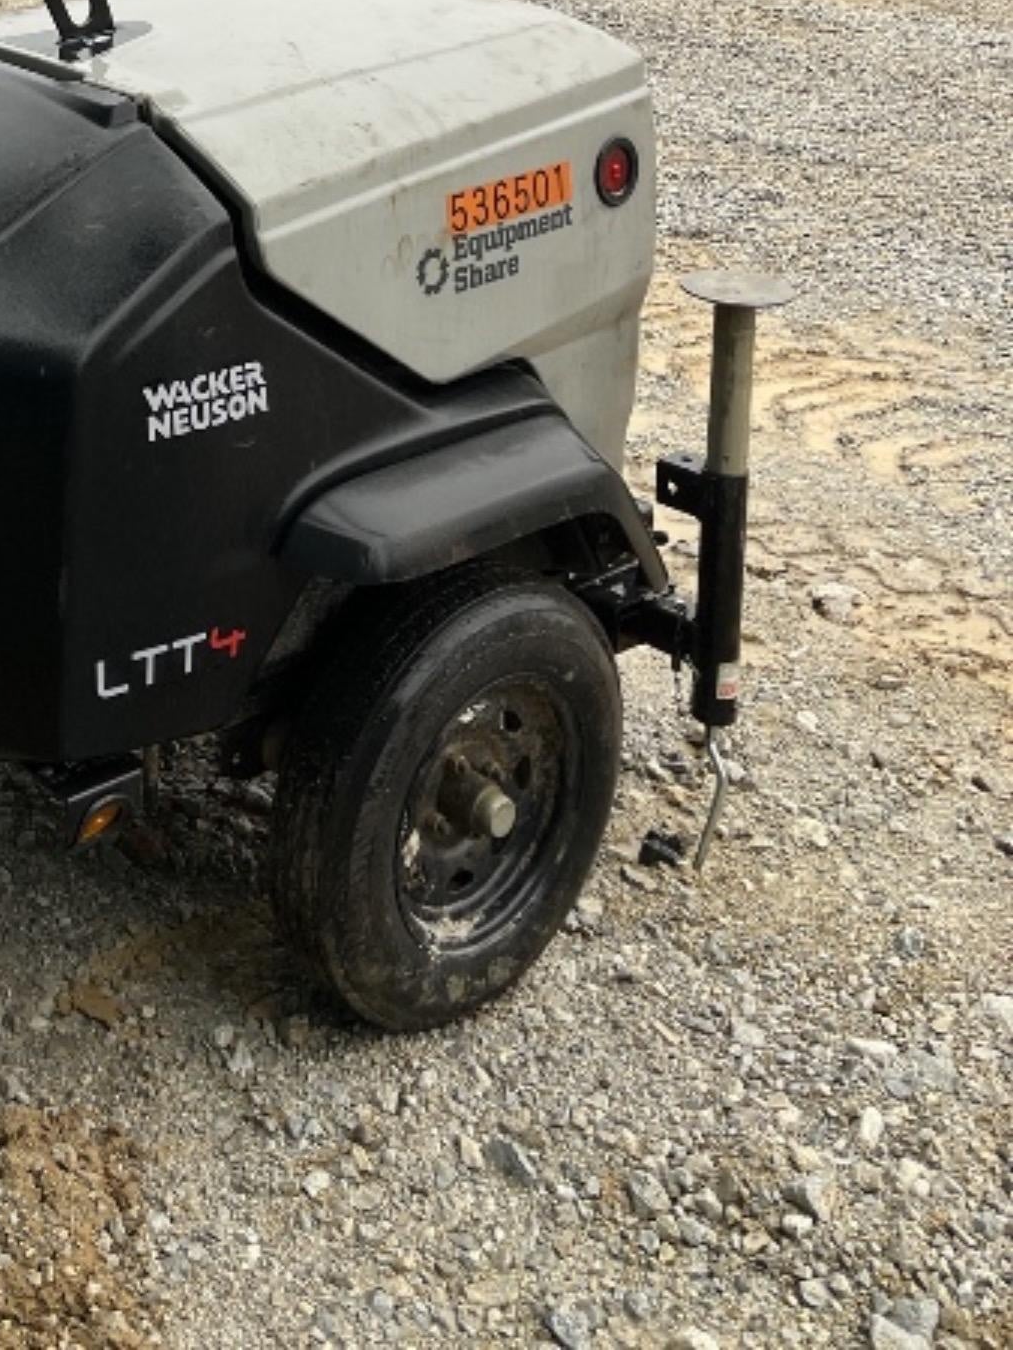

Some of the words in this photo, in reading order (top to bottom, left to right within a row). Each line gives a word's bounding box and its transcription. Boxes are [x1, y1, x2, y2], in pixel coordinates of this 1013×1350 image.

[450, 164, 565, 232] 536501
[452, 203, 573, 261] Equipment
[453, 255, 519, 293] Share
[142, 361, 267, 412] WACKER
[148, 386, 269, 442] NEUSON
[95, 627, 247, 698] LTT4
